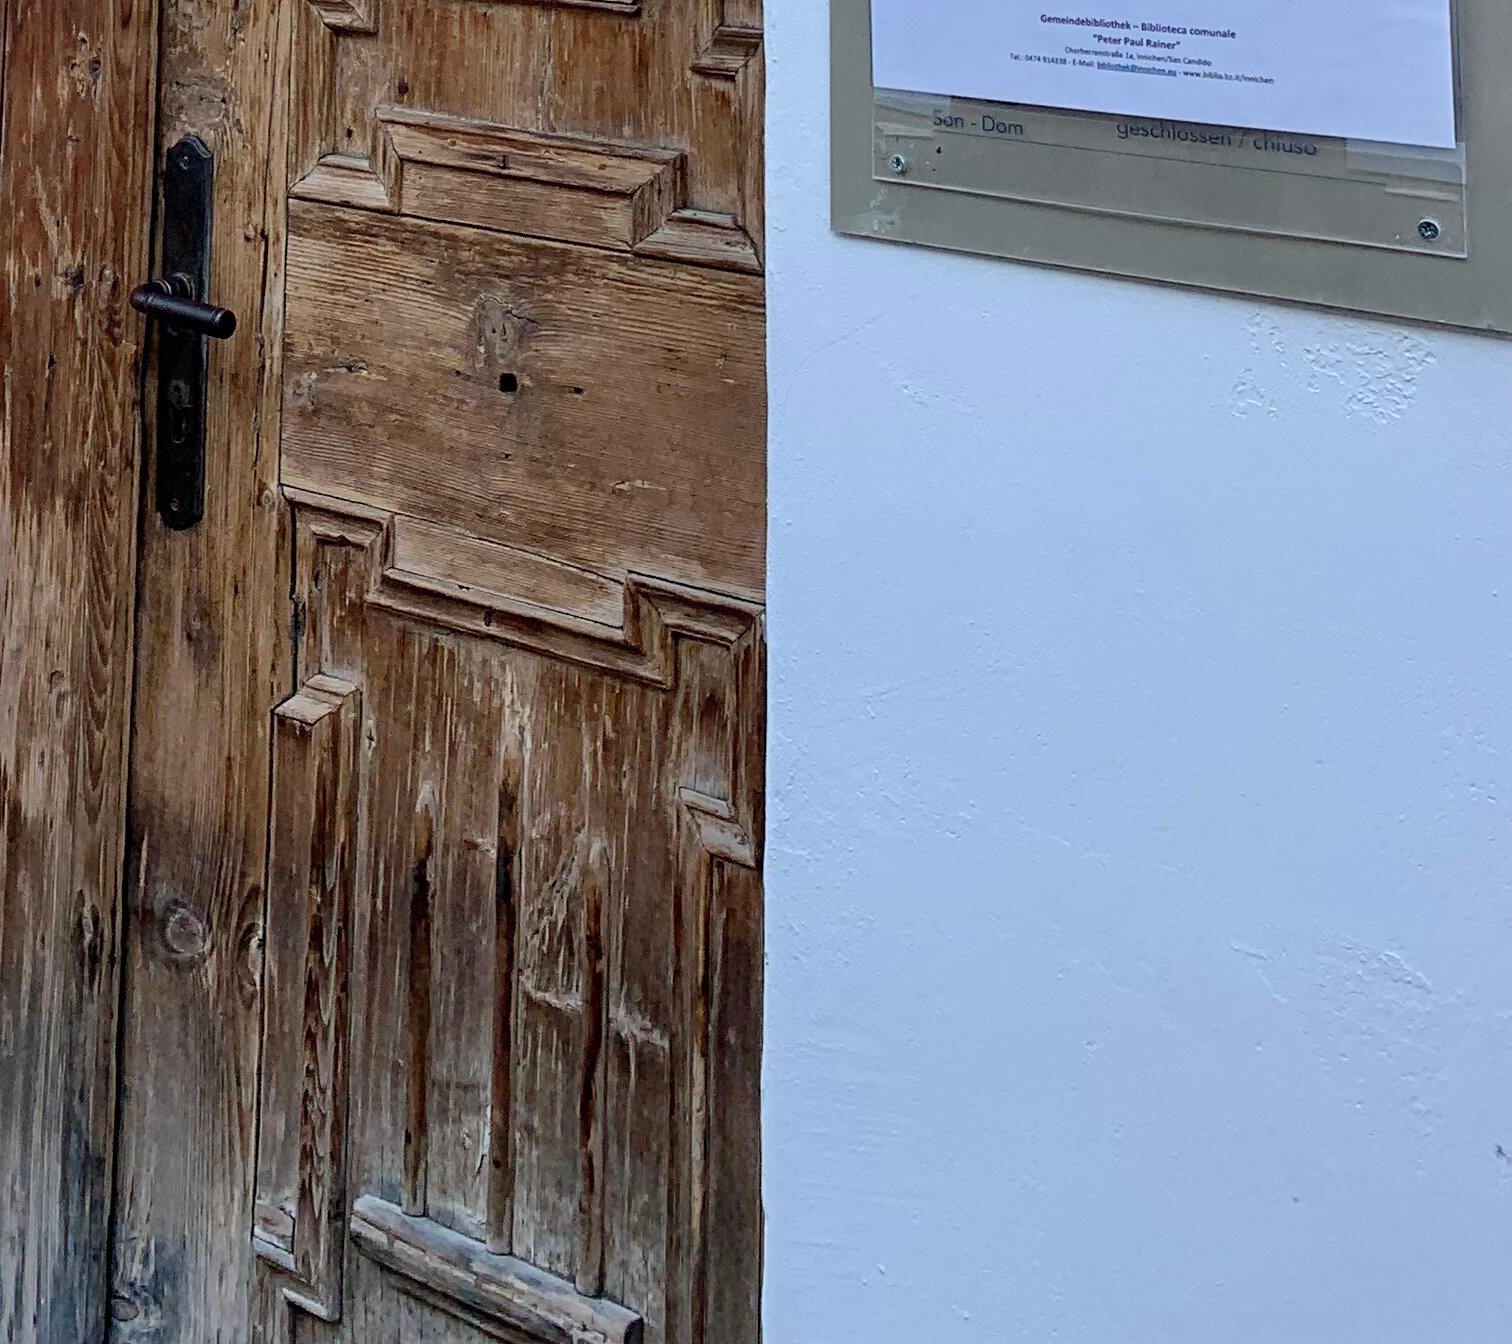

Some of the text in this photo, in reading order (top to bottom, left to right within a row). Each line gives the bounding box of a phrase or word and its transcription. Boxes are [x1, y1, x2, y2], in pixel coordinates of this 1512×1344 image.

[1040, 14, 1131, 30] Gemeindebibliothek
[1141, 22, 1187, 35] Biblioteca
[1190, 27, 1236, 39] comunale
[1124, 37, 1143, 47] Paul
[982, 115, 1024, 135] Dom
